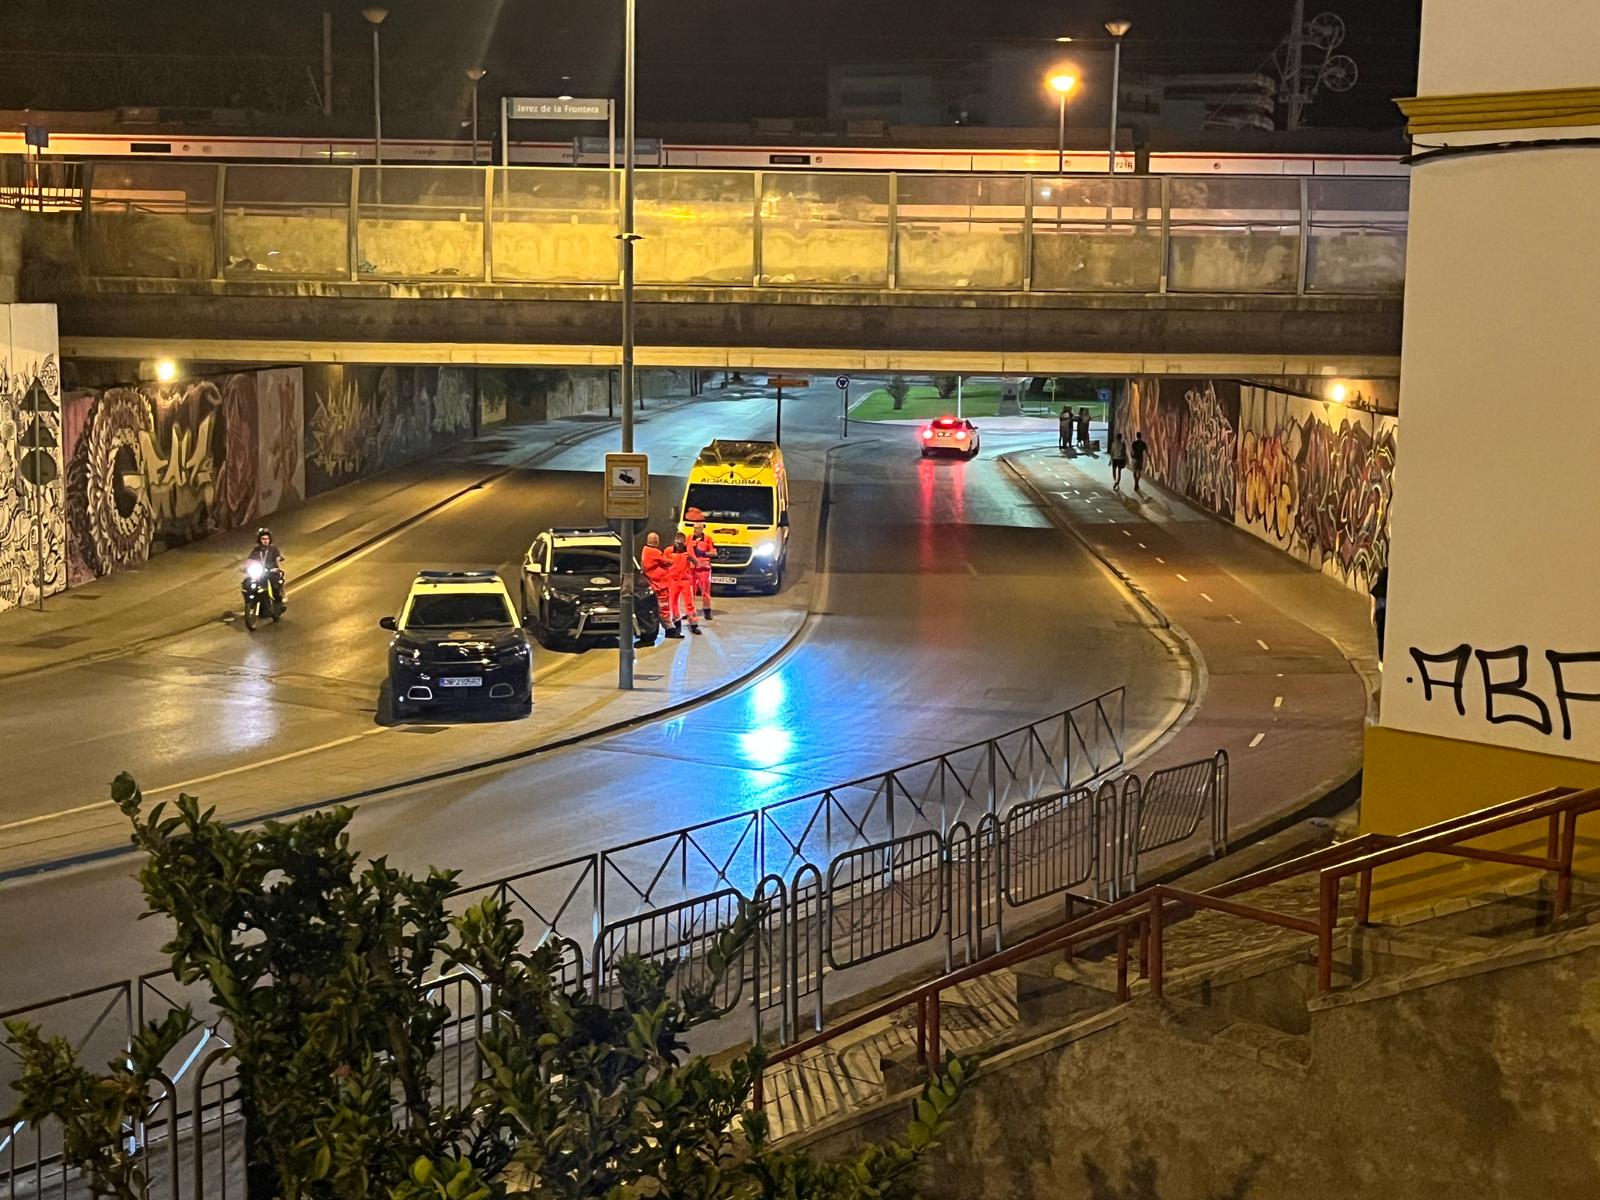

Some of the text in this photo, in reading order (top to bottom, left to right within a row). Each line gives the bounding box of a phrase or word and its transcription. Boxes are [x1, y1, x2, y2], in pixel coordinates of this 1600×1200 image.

[516, 104, 600, 114] Jerez de la Frontera
